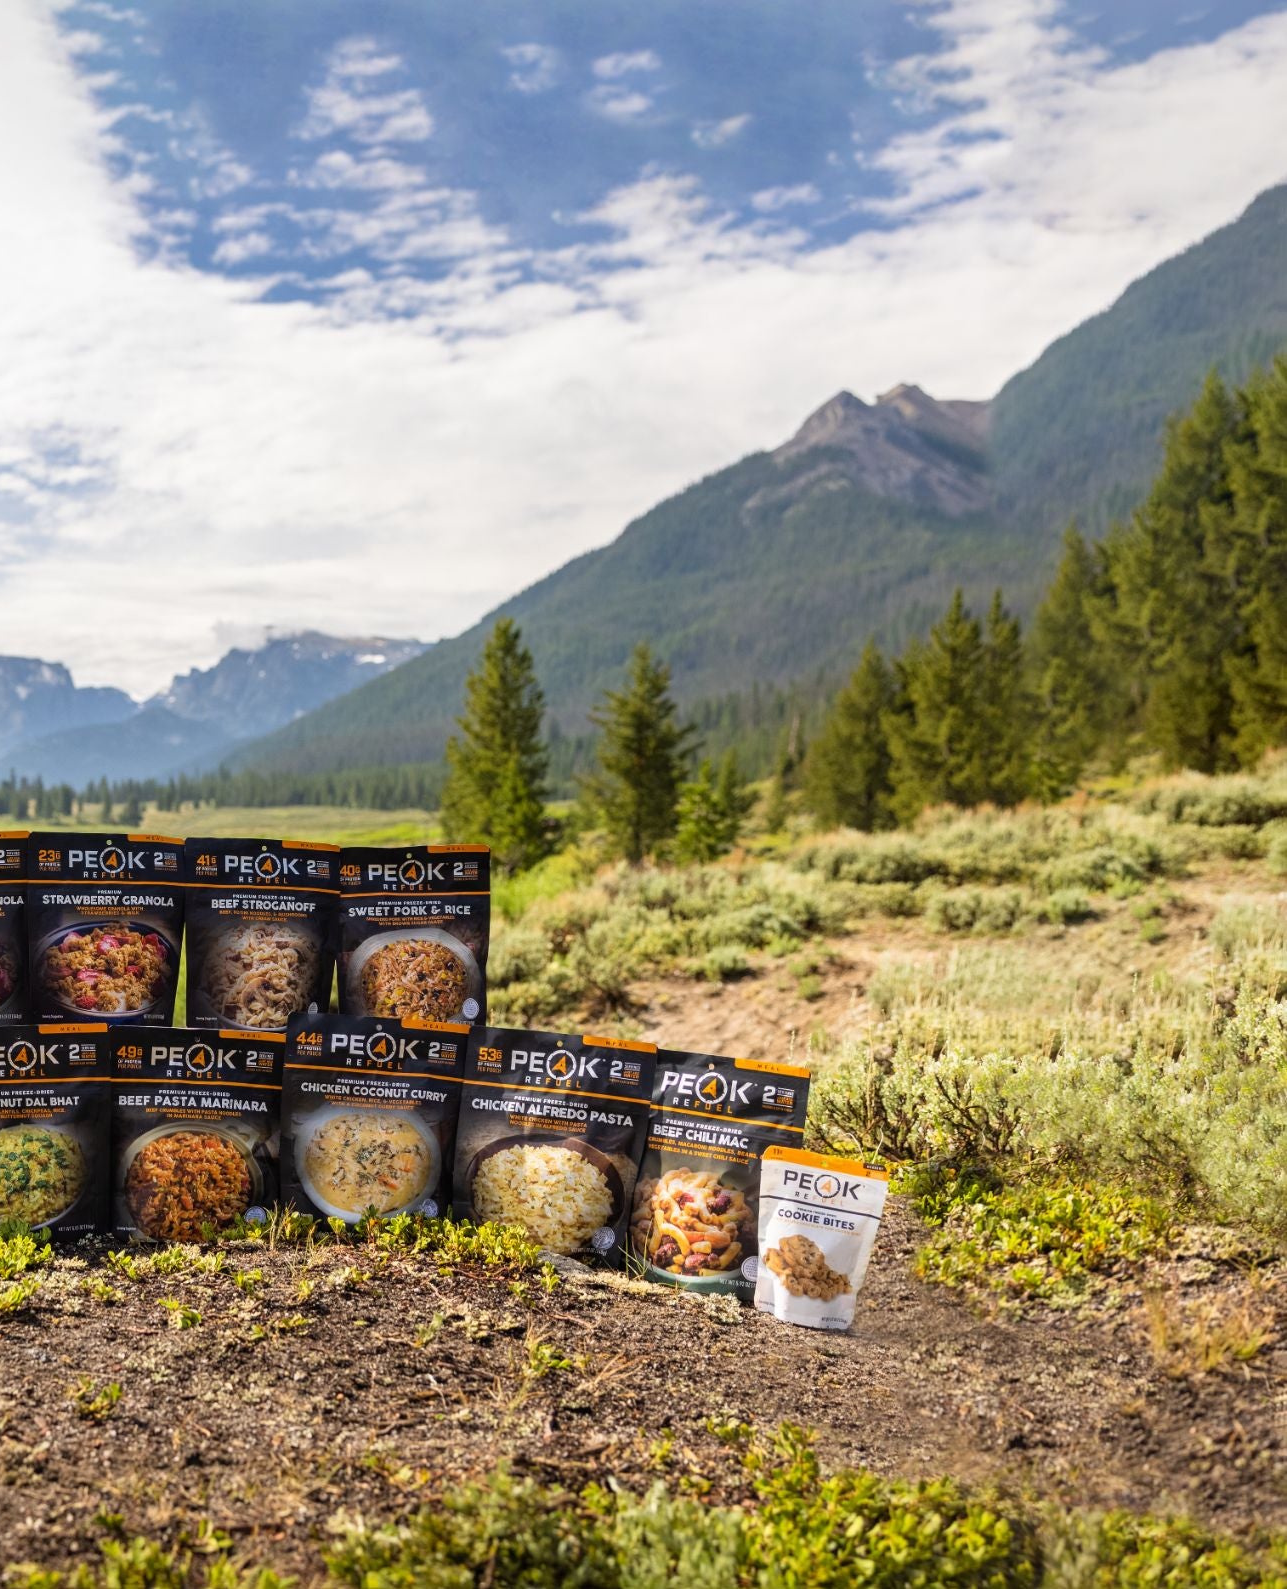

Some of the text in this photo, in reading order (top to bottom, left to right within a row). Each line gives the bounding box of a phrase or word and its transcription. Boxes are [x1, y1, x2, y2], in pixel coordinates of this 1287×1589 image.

[154, 852, 163, 865] 2
[307, 860, 316, 872] 2
[454, 863, 463, 875] 2
[239, 876, 288, 884] REFUEL
[43, 895, 174, 907] STRAWBERRY GRANOLA
[212, 899, 316, 912] BEEF STROGANOFF
[349, 906, 470, 917] SWEET PORK & RICE
[296, 1032, 322, 1044] 44G
[69, 1044, 79, 1059] 2
[428, 1042, 440, 1058] 2
[478, 1047, 502, 1061] 53G
[246, 1051, 257, 1066] 2
[346, 1058, 402, 1069] REFUEL
[167, 1070, 222, 1079] REFUEL
[609, 1061, 623, 1077] 2
[525, 1076, 581, 1088] REFUEL
[301, 1082, 447, 1103] CHICKEN COCONUT CURRY
[762, 1086, 776, 1103] 2
[26, 1097, 47, 1107] DAL
[50, 1096, 79, 1106] BHAT
[119, 1096, 268, 1112] BEEF PASTA MARINARA
[514, 1095, 589, 1109] PREMIUM FREEZE-DRIED
[673, 1097, 733, 1114] REFUEL
[472, 1098, 634, 1127] CHICKEN ALFREDO PASTA
[666, 1118, 743, 1135] PREMIUM FREEZE-DRIED
[653, 1124, 749, 1149] BEEF CHILI MAC
[778, 1208, 820, 1224] COOKIE
[824, 1218, 855, 1230] BITES
